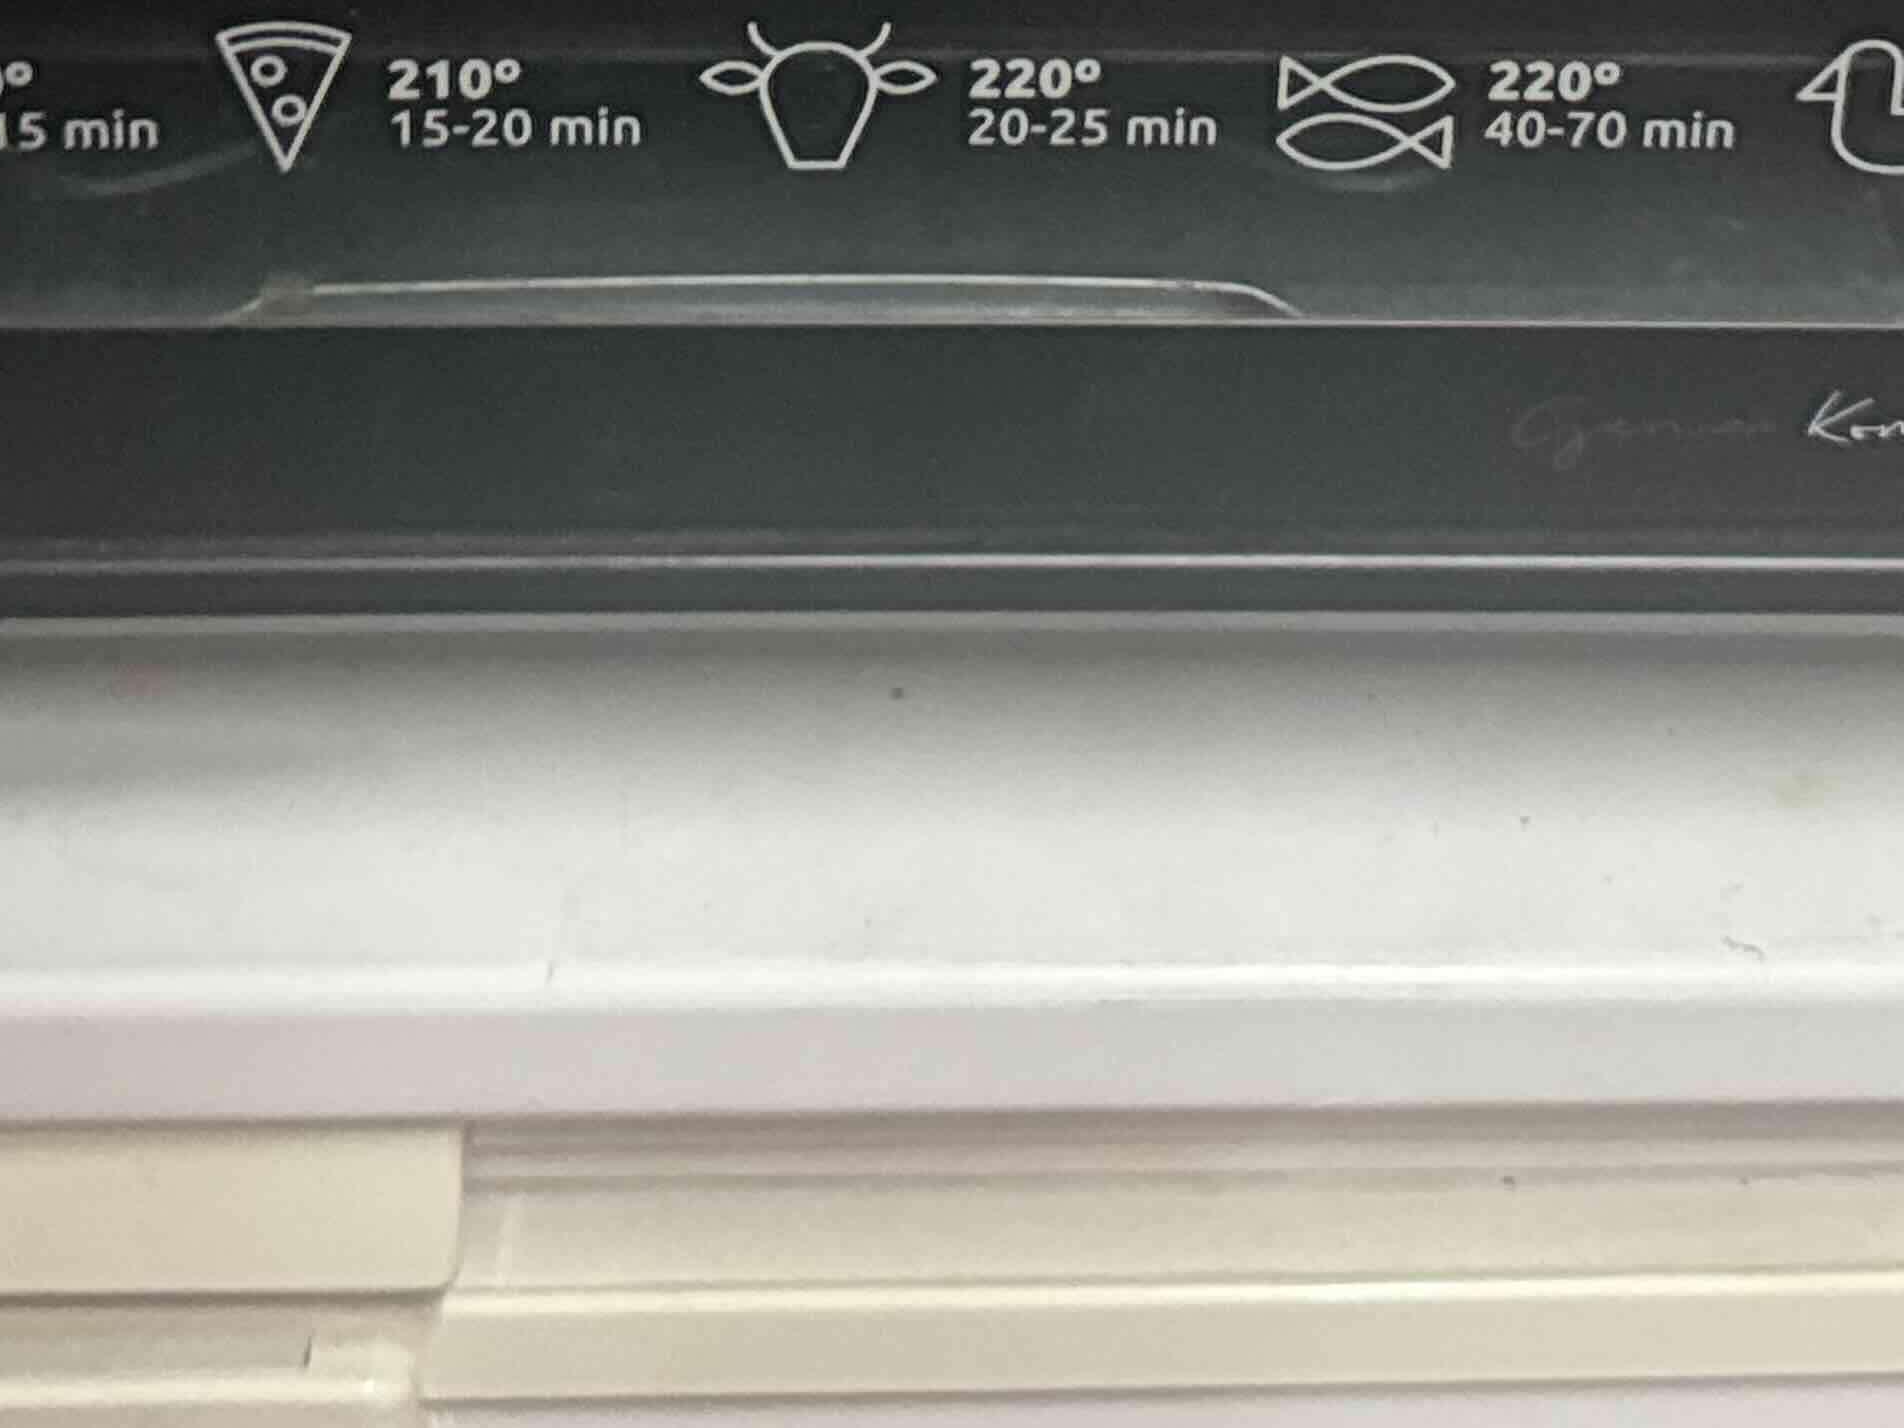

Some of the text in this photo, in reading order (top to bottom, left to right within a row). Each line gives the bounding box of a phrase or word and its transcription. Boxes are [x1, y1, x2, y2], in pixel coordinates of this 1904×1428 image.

[62, 108, 160, 151] min
[390, 105, 642, 149] 15-20 min
[967, 105, 1219, 148] 20-25 min
[1483, 108, 1736, 150] 40-70 min
